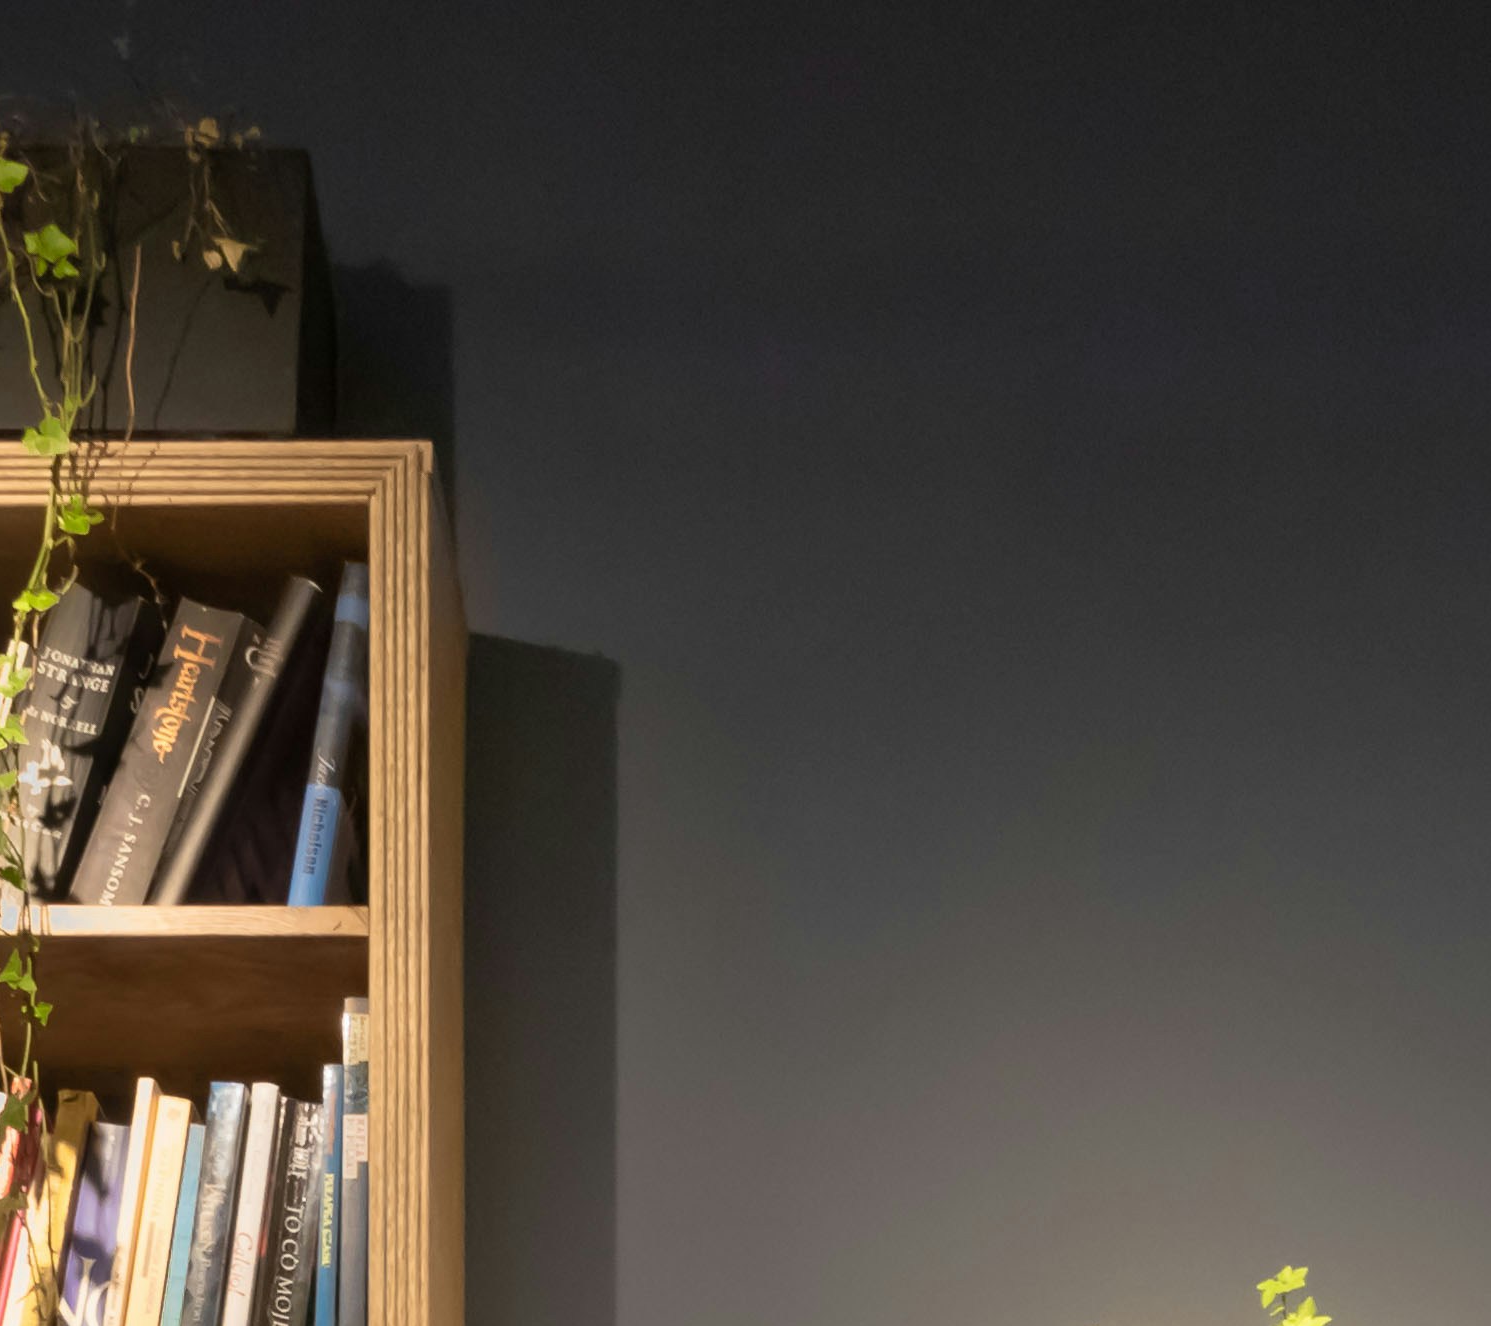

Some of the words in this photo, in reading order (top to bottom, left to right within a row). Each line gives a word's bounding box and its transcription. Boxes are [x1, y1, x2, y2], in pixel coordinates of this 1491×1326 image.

[311, 755, 338, 793] Jack
[301, 795, 332, 877] Nicholson
[96, 829, 135, 908] SANSOM
[282, 1200, 312, 1233] TO
[277, 1237, 309, 1270] CO
